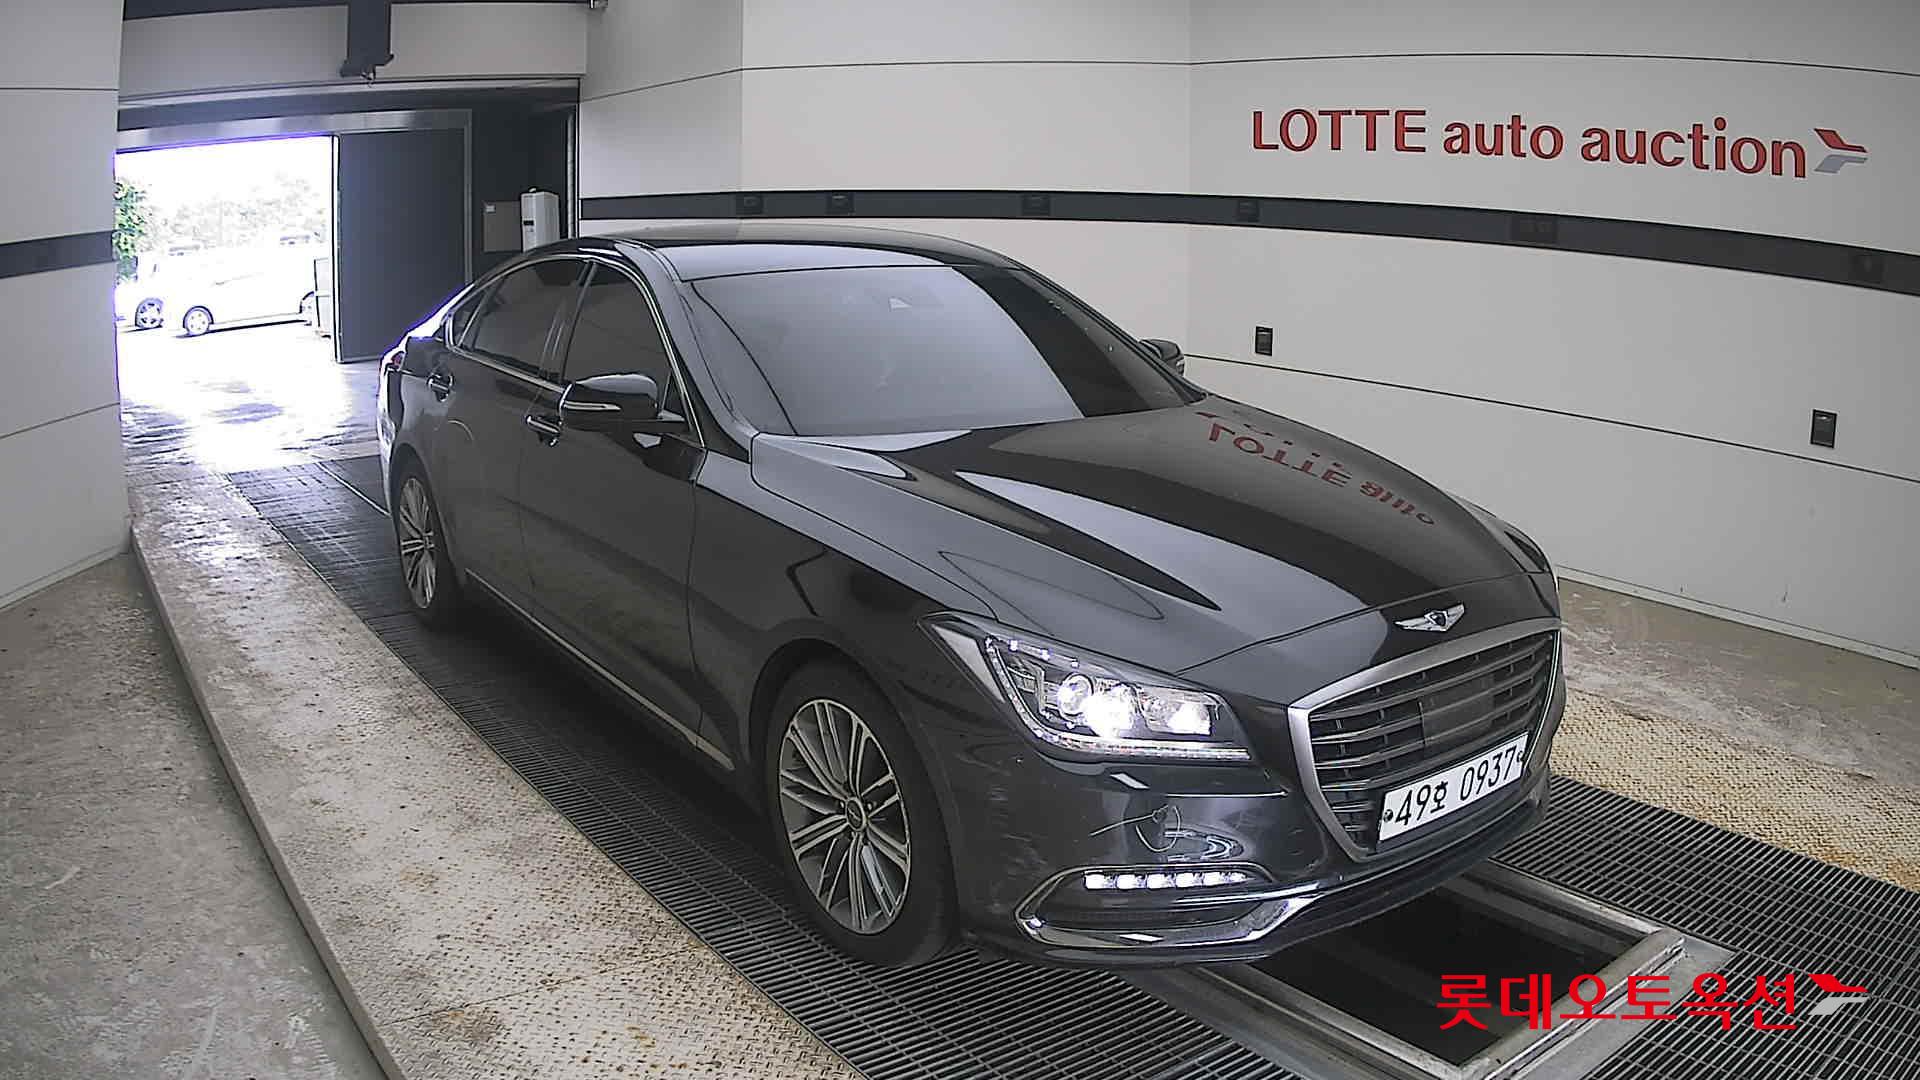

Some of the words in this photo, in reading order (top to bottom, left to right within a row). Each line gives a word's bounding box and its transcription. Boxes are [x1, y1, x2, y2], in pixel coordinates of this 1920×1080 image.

[1252, 109, 1427, 153] LOTTE
[1443, 114, 1565, 160] auto
[1580, 116, 1807, 179] auction
[1395, 780, 1449, 826] 49호
[1459, 744, 1518, 801] 0937
